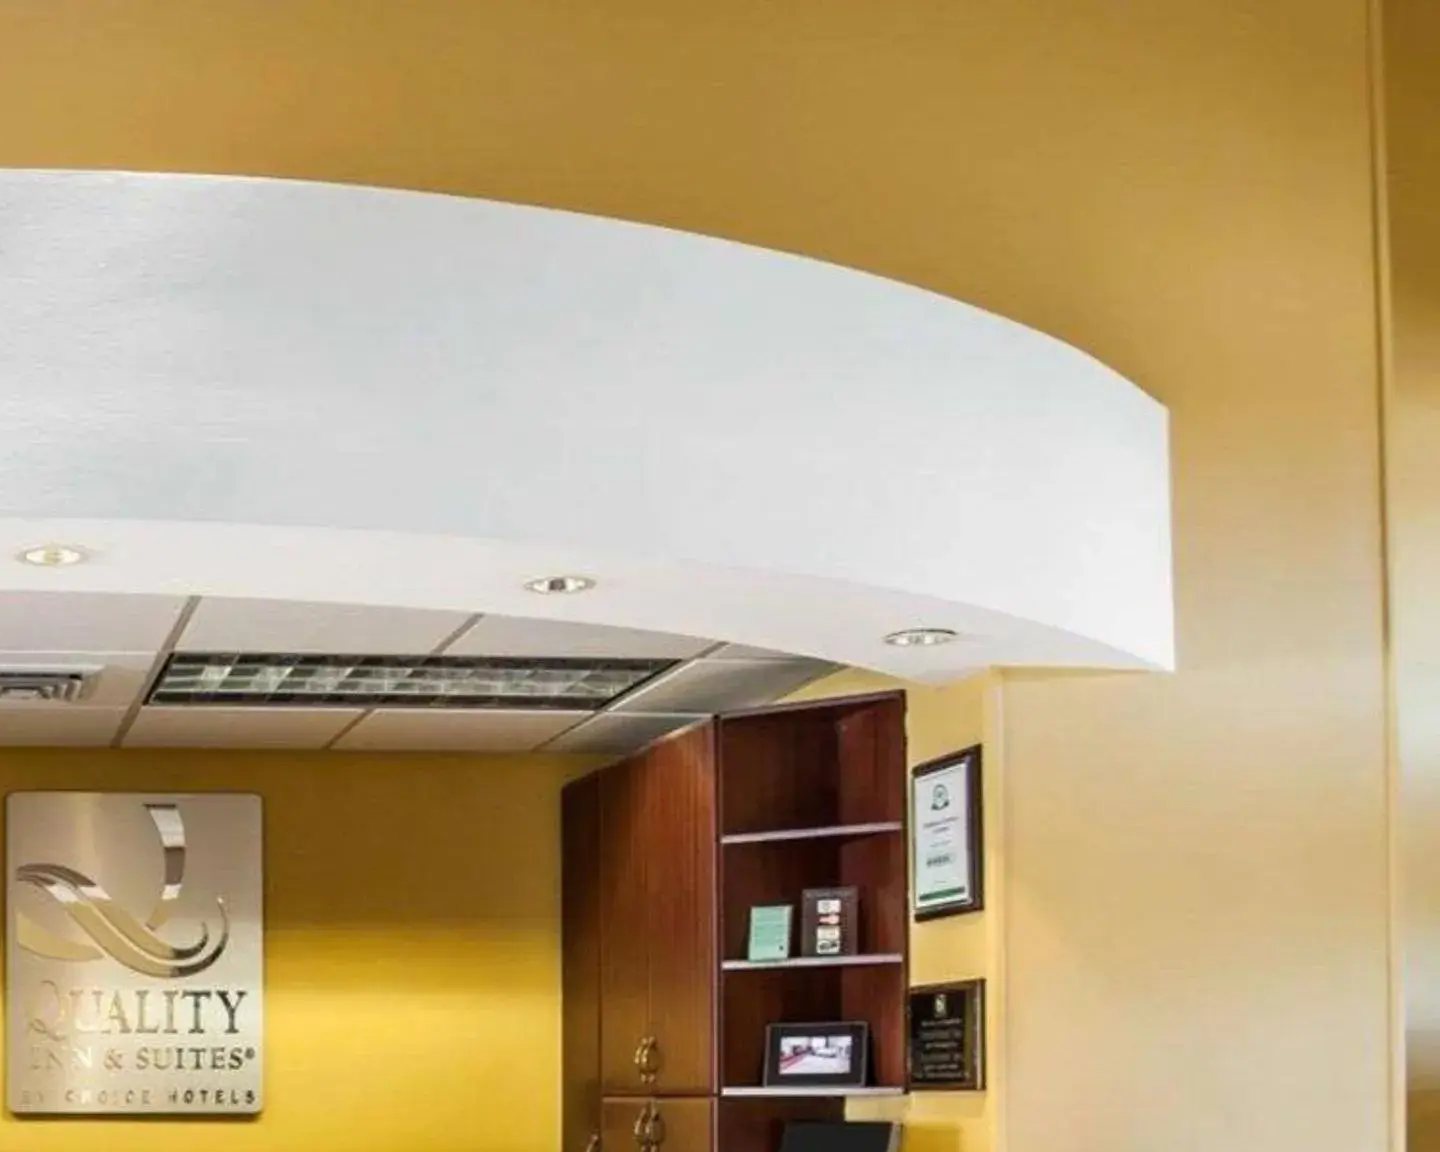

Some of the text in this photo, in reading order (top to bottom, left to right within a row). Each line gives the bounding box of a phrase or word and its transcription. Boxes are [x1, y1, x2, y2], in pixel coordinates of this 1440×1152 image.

[27, 980, 248, 1042] QUALITY
[103, 1048, 124, 1070] &
[169, 1089, 256, 1104] HOTELS
